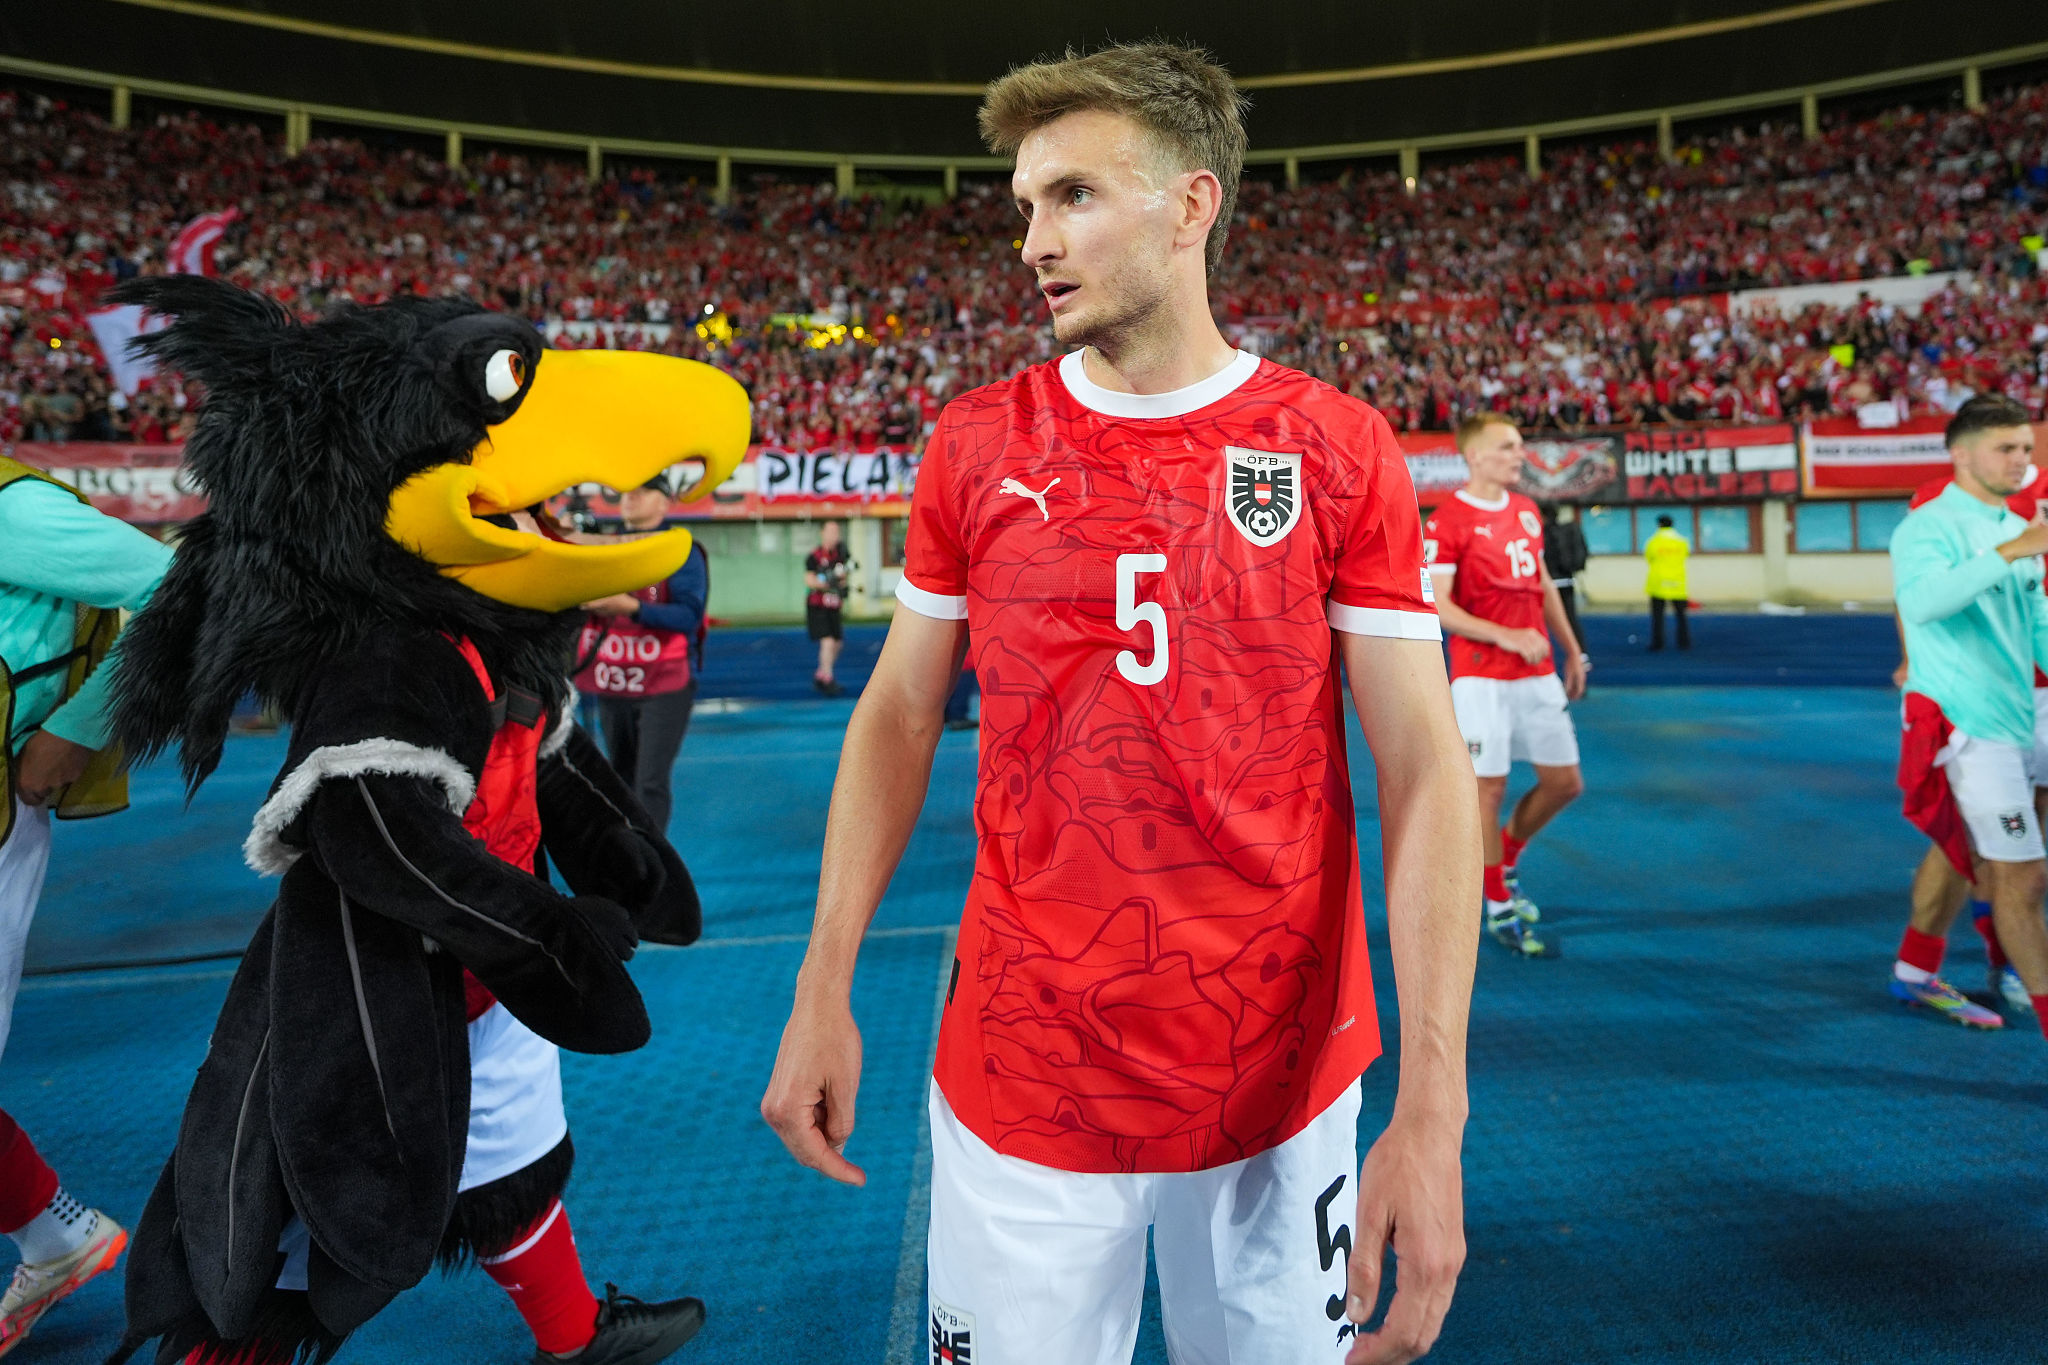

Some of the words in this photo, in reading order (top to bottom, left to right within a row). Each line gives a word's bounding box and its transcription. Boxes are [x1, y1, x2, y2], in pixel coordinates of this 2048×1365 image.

[1247, 455, 1279, 466] ÖFB
[1625, 448, 1732, 476] WHITE
[1627, 472, 1763, 499] EAGLES
[1505, 539, 1537, 579] 15
[1115, 553, 1170, 686] 5
[594, 662, 645, 692] 032
[1314, 1174, 1352, 1322] 5
